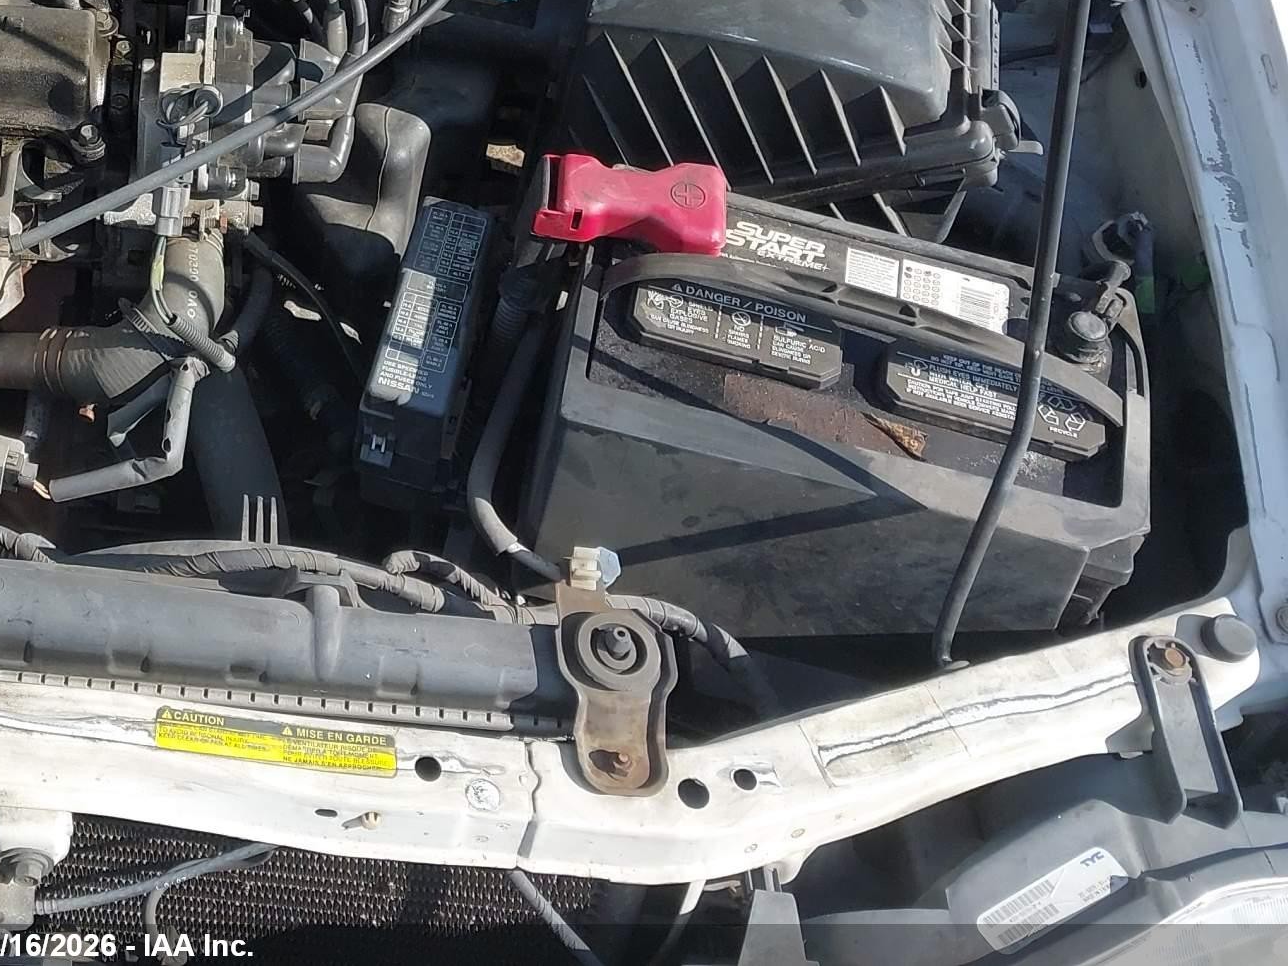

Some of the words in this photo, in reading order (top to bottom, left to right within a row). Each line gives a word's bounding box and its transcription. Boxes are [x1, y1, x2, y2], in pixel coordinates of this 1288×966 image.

[725, 229, 826, 263] START
[736, 220, 826, 253] SUPER
[685, 284, 741, 307] DANGER
[755, 302, 806, 323] POISON
[670, 308, 708, 322] EXPLOSIVE
[670, 313, 693, 324] GASES
[773, 334, 807, 349] SULFURIC
[808, 344, 826, 353] ACID
[377, 376, 420, 395] NISSAN
[415, 380, 432, 390] ONLY
[928, 375, 958, 391] MEDICAL
[980, 388, 997, 399] FAST
[929, 364, 951, 375] FLUSH
[953, 370, 970, 380] EYES
[972, 375, 1018, 392] IMMEDIATELY
[1049, 426, 1079, 439] RECYCLE
[173, 710, 225, 726] CAUTION
[296, 727, 324, 740] MISE
[327, 731, 343, 742] EN
[346, 733, 388, 746] GARDE
[1080, 851, 1105, 868] TYC
